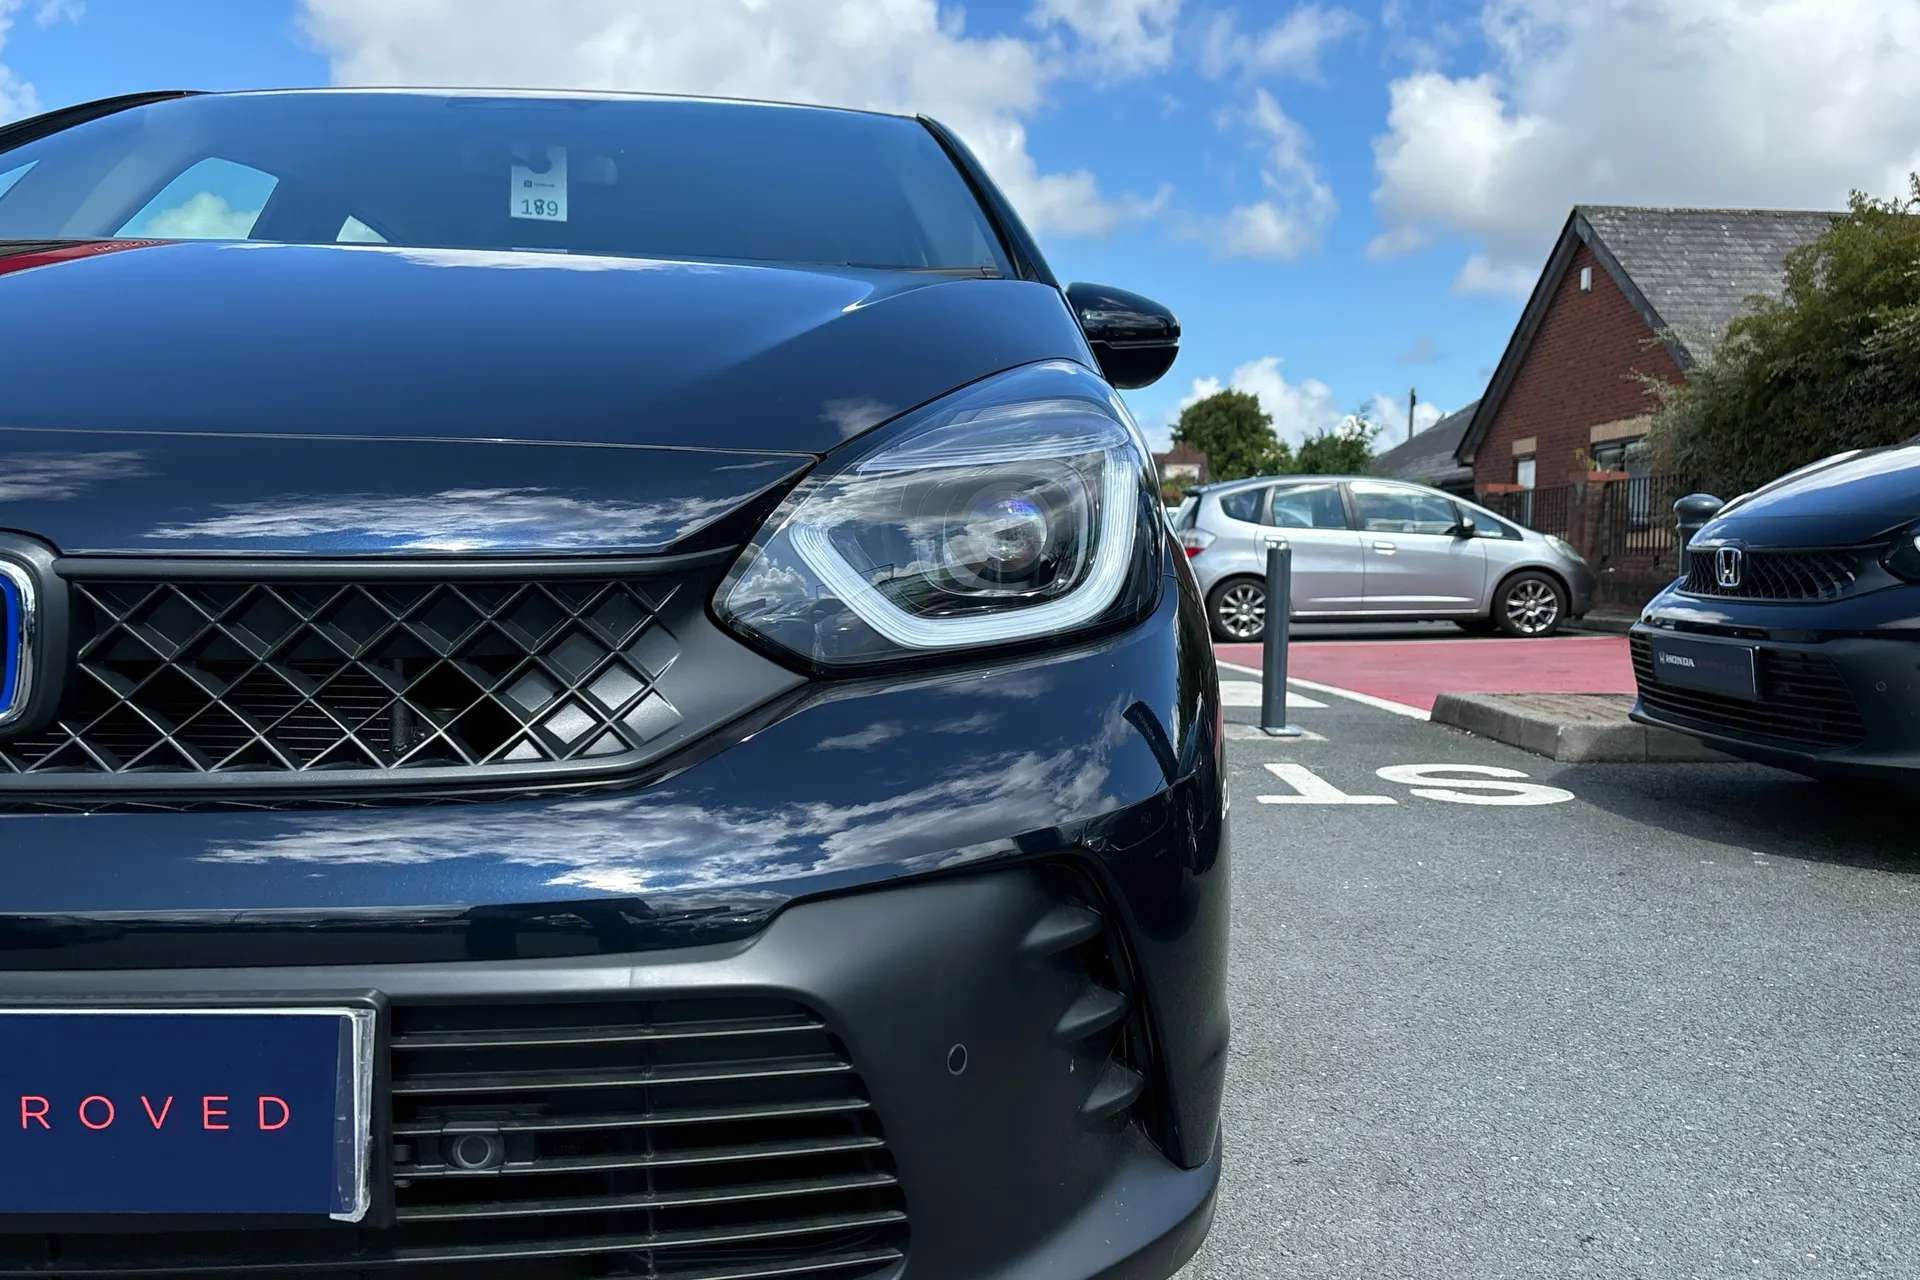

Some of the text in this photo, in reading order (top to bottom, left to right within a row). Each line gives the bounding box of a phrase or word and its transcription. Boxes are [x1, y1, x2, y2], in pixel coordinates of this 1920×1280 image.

[521, 198, 559, 217] 189
[1665, 653, 1695, 668] HONDA
[20, 1095, 292, 1131] ROVED
